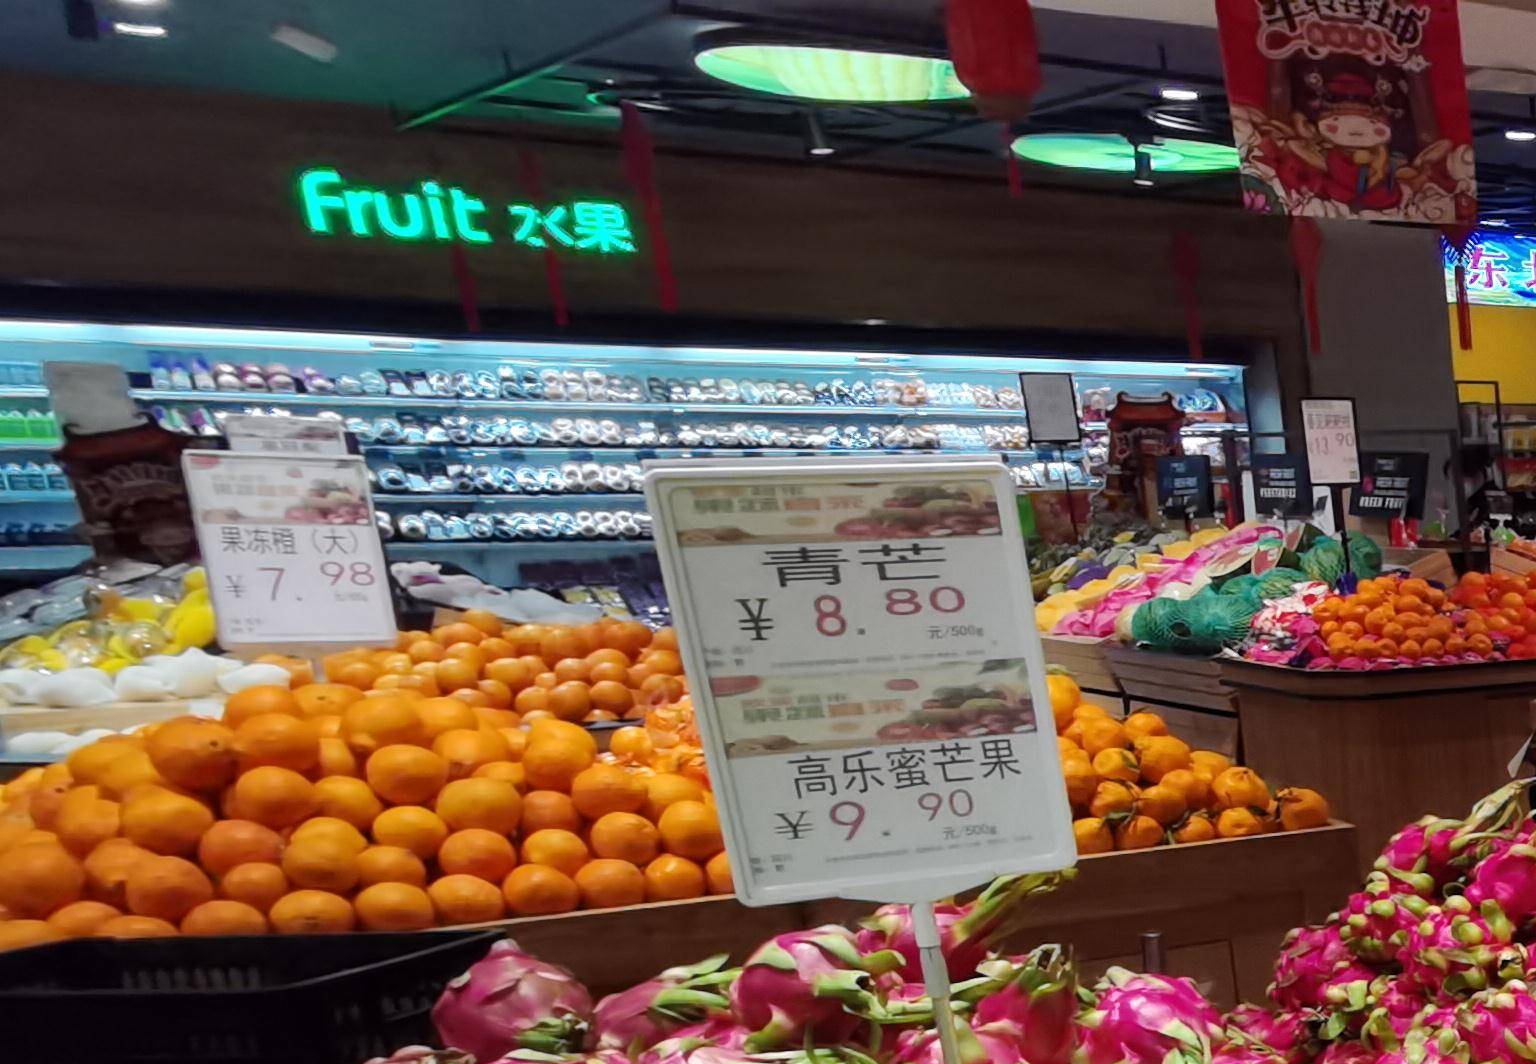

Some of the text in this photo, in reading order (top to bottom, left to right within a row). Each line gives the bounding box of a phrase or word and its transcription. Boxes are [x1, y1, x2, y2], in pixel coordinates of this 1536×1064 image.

[300, 168, 640, 253] Fruit 水果
[761, 542, 947, 588] 青芒
[787, 738, 1023, 800] 高乐蜜芒果
